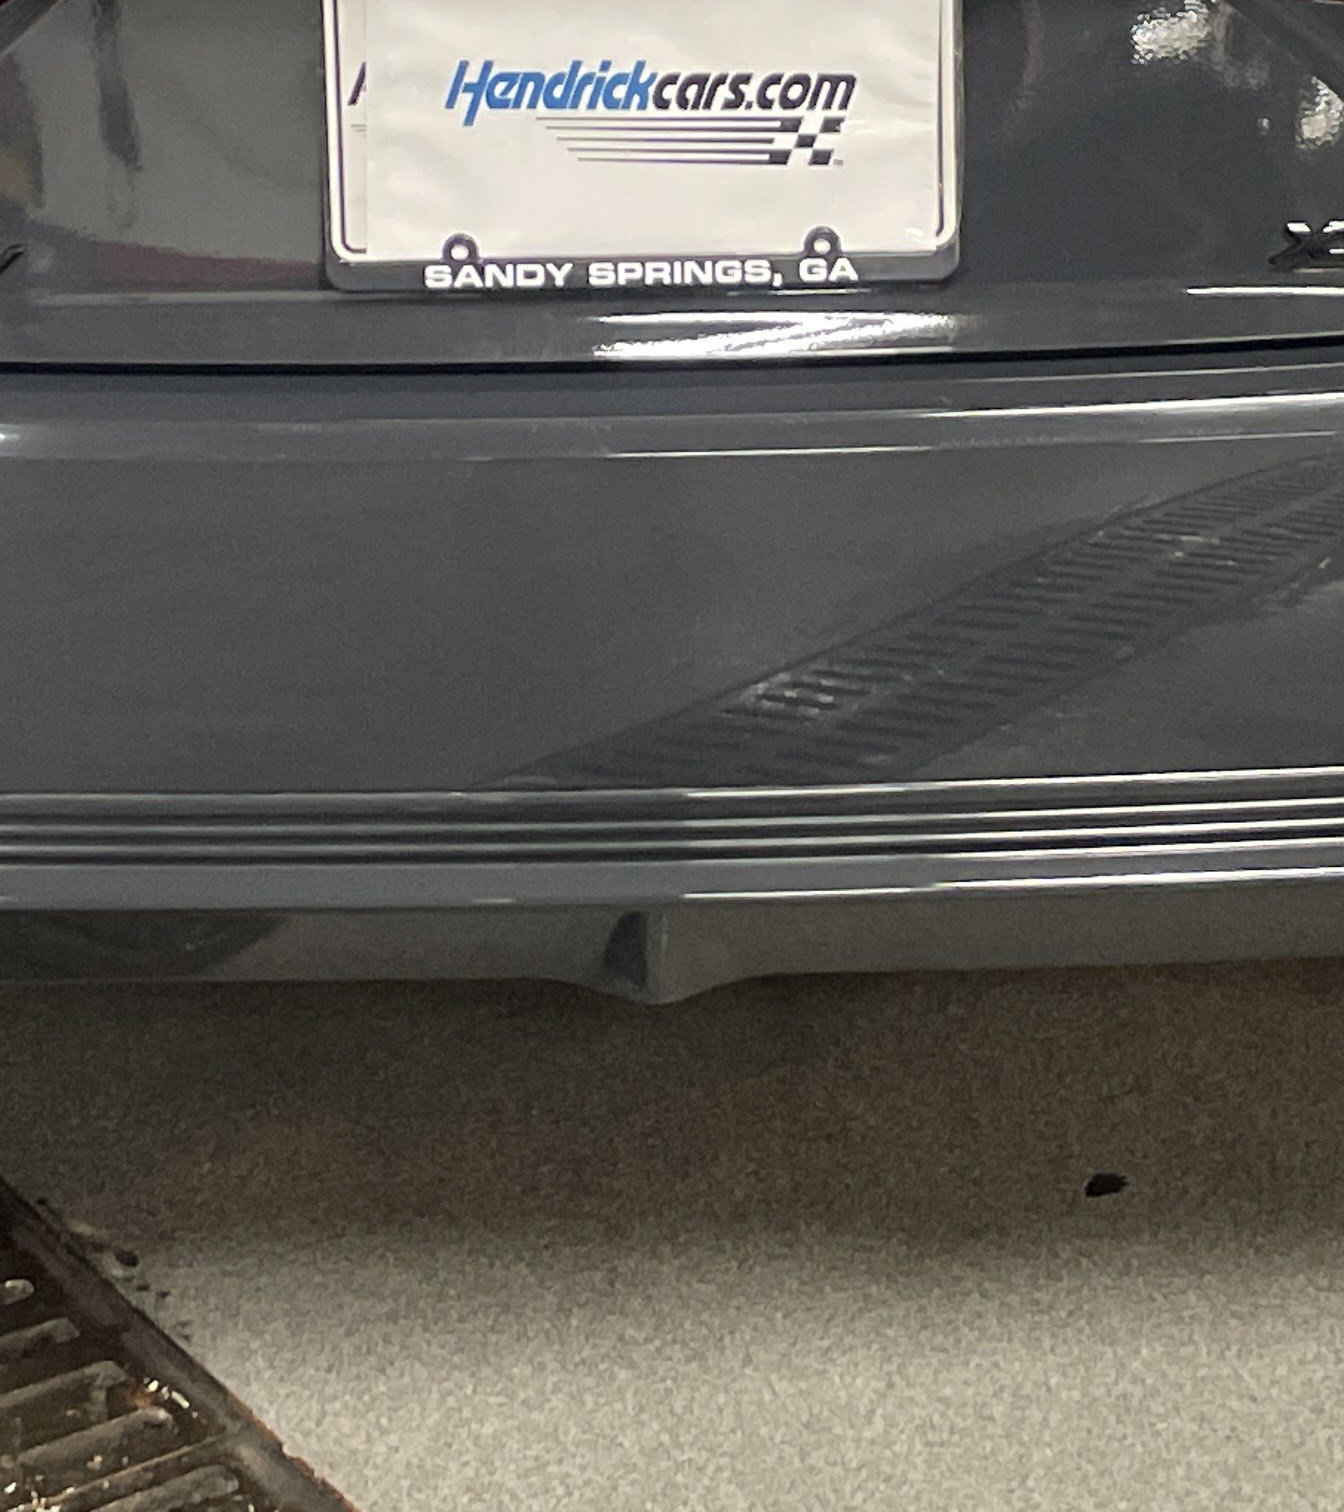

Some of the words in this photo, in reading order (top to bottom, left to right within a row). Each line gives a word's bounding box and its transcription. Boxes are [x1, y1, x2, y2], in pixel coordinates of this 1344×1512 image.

[444, 59, 857, 127] Hendrickcars.com
[423, 262, 574, 289] SANDY
[587, 259, 783, 288] SPRINGS,
[798, 257, 859, 283] GA
